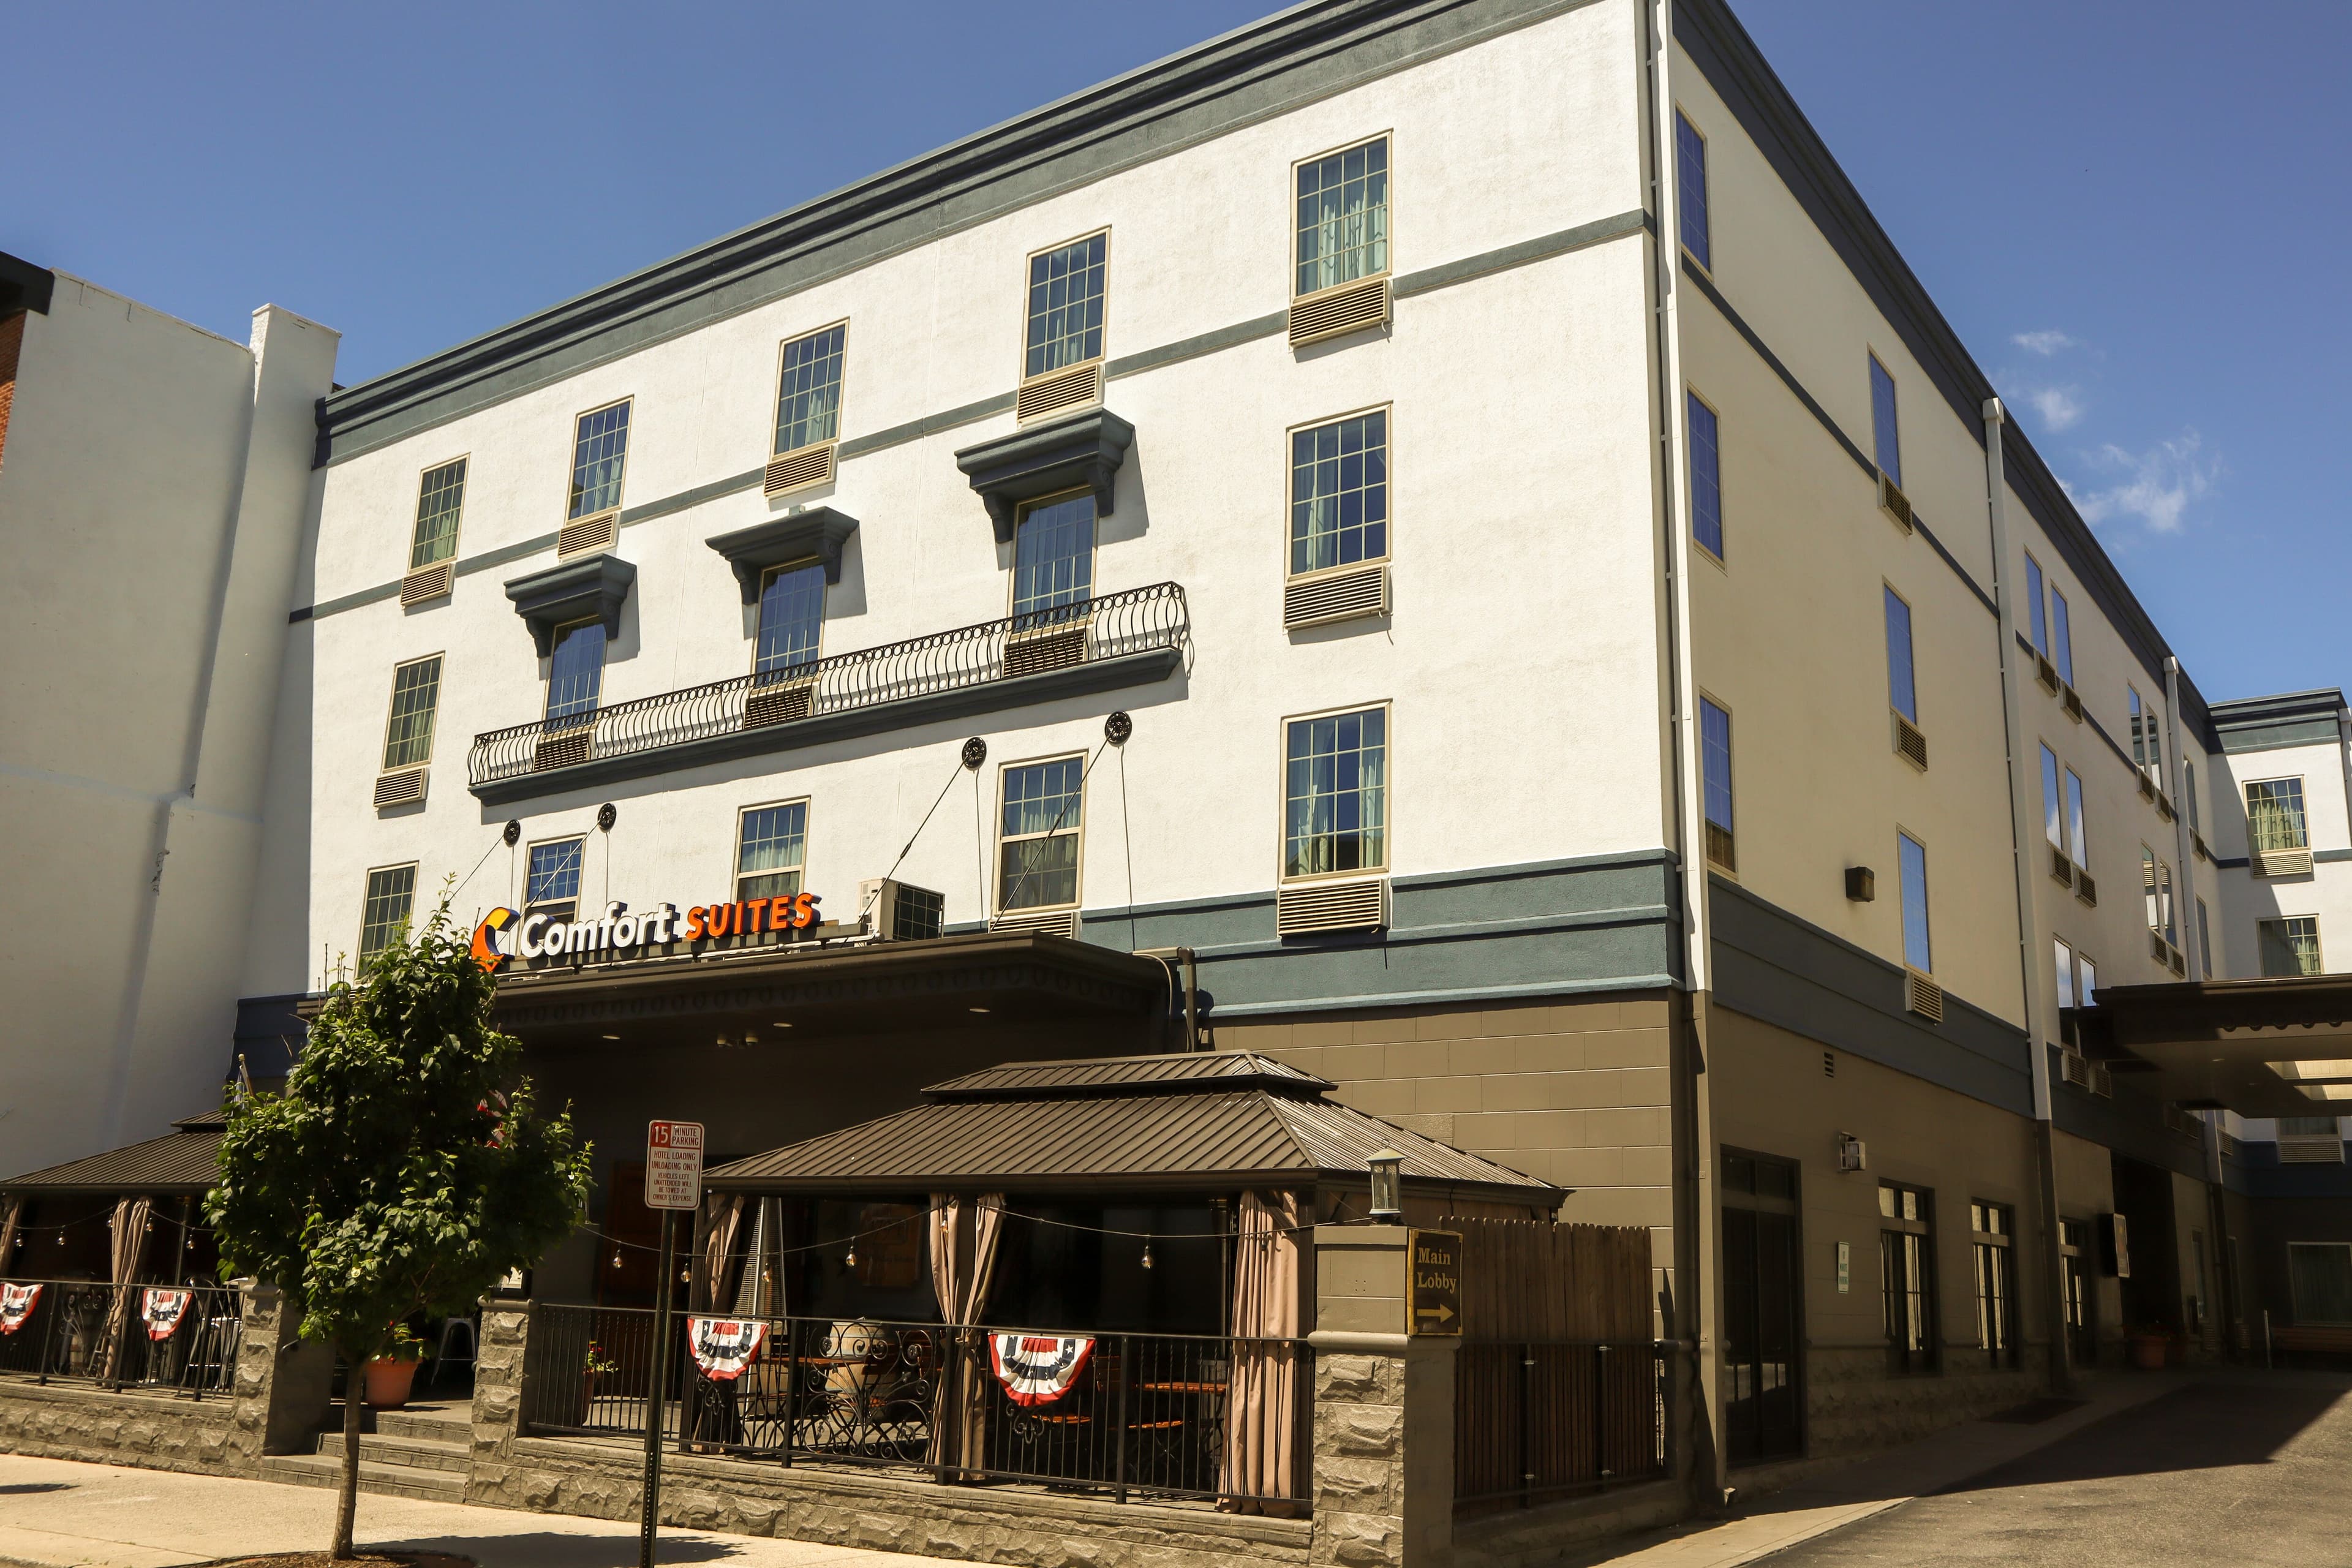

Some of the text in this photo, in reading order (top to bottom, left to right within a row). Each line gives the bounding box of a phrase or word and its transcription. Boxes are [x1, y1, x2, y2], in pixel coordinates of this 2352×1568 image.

[521, 901, 680, 959] Comfort
[685, 893, 821, 940] SUITES
[654, 1126, 669, 1144] 15
[674, 1127, 697, 1136] MINUTE
[672, 1136, 699, 1146] PARKING
[654, 1150, 696, 1161] HOTEL LOADING
[651, 1161, 698, 1171] UNLOADING ONLY
[1417, 1247, 1451, 1265] Main
[1417, 1272, 1457, 1294] Lobby
